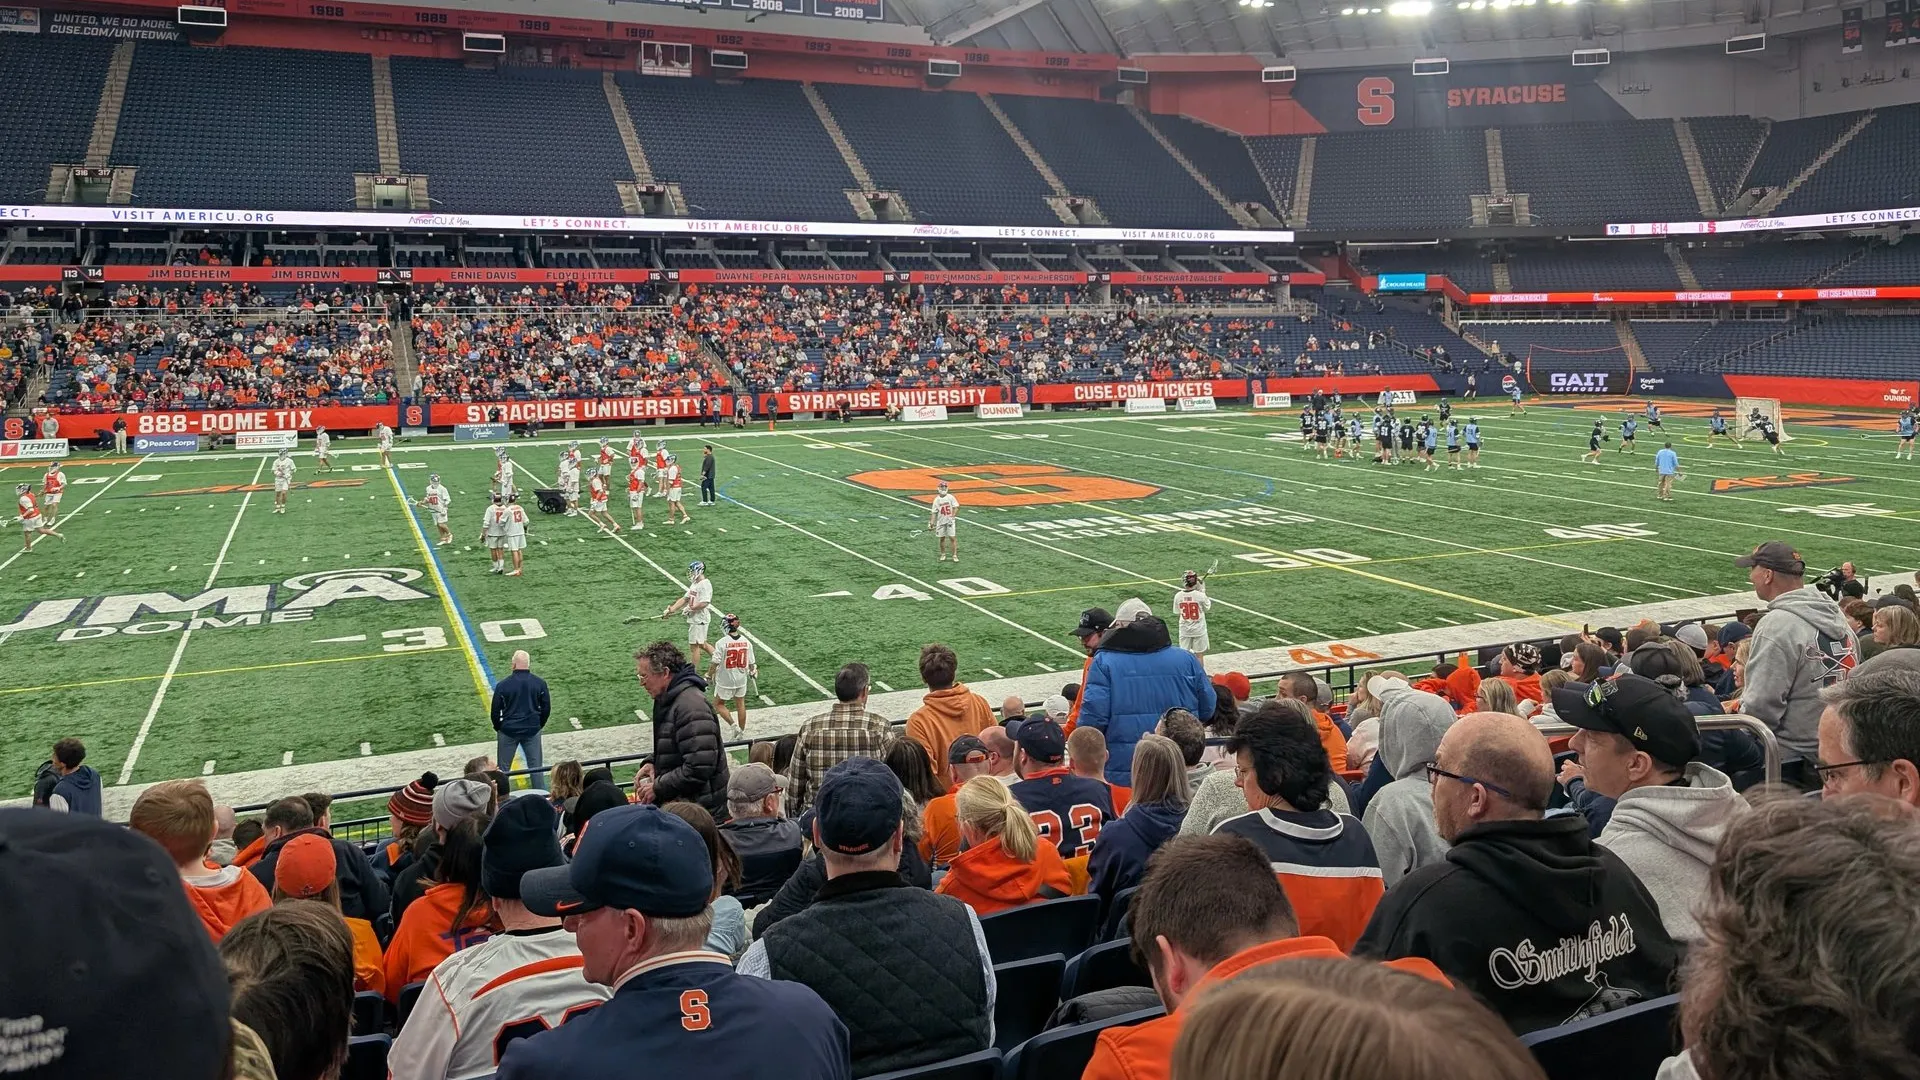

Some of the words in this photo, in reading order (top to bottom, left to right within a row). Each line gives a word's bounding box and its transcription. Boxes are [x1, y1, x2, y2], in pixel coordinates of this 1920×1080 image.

[752, 0, 782, 11] 2008
[835, 6, 864, 18] 2009
[53, 13, 99, 26] UNITED,
[102, 17, 119, 26] WE
[122, 18, 138, 27] DO
[141, 20, 175, 30] MORE.
[50, 25, 180, 41] CUSE.COM/UNITEDWAY
[1357, 76, 1395, 126] S
[1448, 84, 1566, 107] SYRACUSE
[112, 210, 155, 221] VISIT
[163, 211, 275, 222] AMERICU.ORG
[523, 218, 559, 228] LET'S
[565, 219, 630, 229] CONNECT.
[687, 221, 720, 231] VISIT
[725, 222, 809, 233] AMERICU.ORG
[998, 228, 1027, 237] LET'S
[1030, 229, 1080, 238] CONNECT.
[1122, 230, 1147, 239] VISIT
[1150, 231, 1216, 240] AMERICU.ORG
[1826, 214, 1856, 223] LET'S
[64, 270, 78, 278] 113
[88, 269, 102, 277] 114
[148, 269, 170, 279] JIM
[174, 269, 231, 279] BOEHEIM
[271, 270, 293, 279] JIM
[296, 270, 340, 279] BROWN
[378, 272, 391, 280] 114
[400, 270, 412, 278] 115
[451, 271, 482, 280] ERNIE
[486, 271, 517, 280] DAVIS
[547, 271, 579, 280] FLOYD
[582, 271, 615, 280] LITTLE
[649, 272, 660, 280] 115
[715, 272, 754, 281] DWAYNE
[798, 273, 858, 282] WASHINGTON
[943, 274, 981, 282] SIMMONS
[1153, 275, 1224, 283] SCHWARTZWALDER
[1551, 373, 1608, 386] GAIT
[887, 388, 986, 407] UNIVERSITY
[1075, 382, 1213, 399] CUSE.COM/TICKETS
[406, 405, 422, 425] S
[584, 398, 703, 418] UNIVERSITY
[982, 406, 1020, 415] DUNKIN'
[4, 418, 24, 439] S
[139, 411, 267, 434] 888-DOME
[275, 410, 312, 430] TIX
[20, 442, 66, 450] TAMA
[940, 505, 951, 515] 45
[1233, 548, 1372, 569] 50
[872, 577, 1012, 601] 40
[0, 576, 435, 632] JMA
[1179, 602, 1199, 620] 38
[57, 608, 314, 642] DOME
[726, 648, 747, 669] 20
[1287, 643, 1383, 664] 44
[1489, 912, 1637, 991] Smithfield
[680, 988, 712, 1031] S
